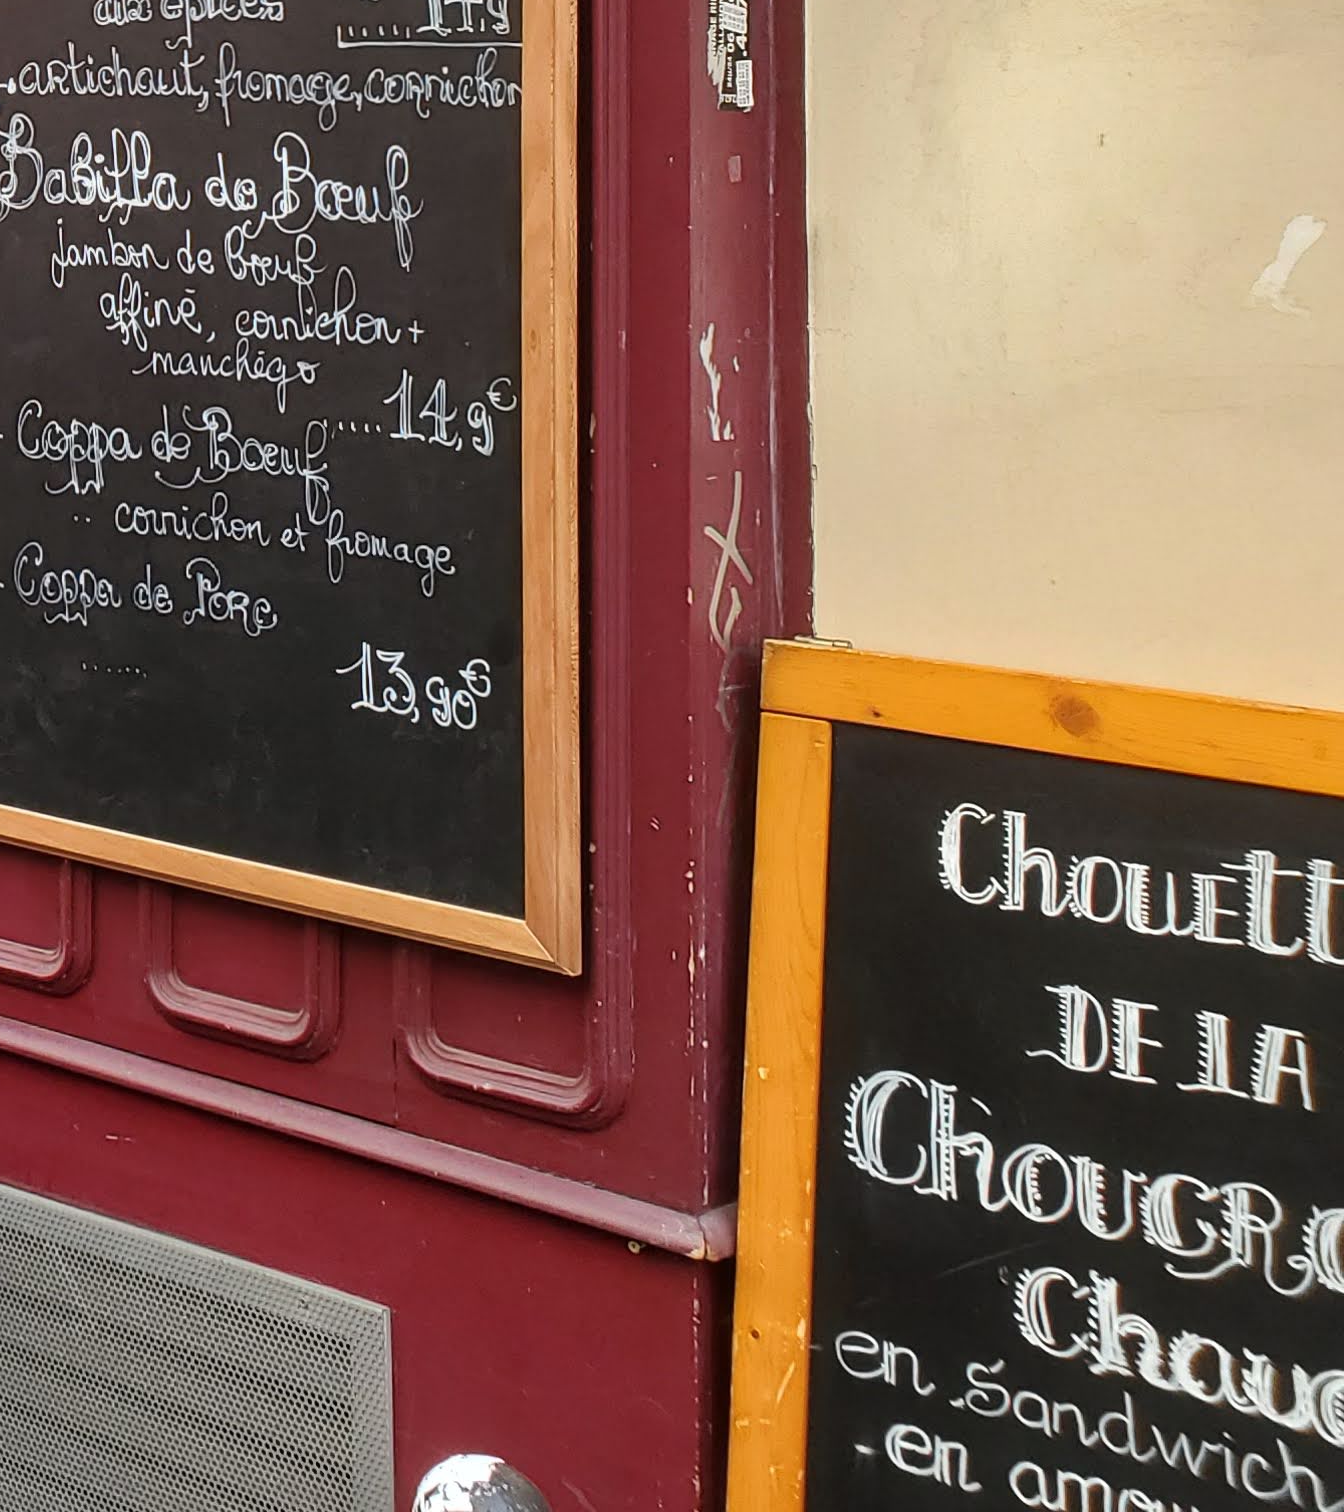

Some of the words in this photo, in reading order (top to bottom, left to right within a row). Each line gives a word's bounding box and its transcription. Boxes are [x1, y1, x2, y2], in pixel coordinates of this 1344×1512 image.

[205, 151, 258, 214] de
[50, 217, 171, 288] jambon
[175, 229, 214, 274] de
[15, 397, 143, 495] Coppa
[150, 404, 192, 464] de
[113, 491, 271, 549] cornichon
[279, 513, 308, 552] et
[324, 509, 457, 598] fromage
[12, 541, 123, 627] Coppa
[132, 563, 174, 615] de
[1026, 983, 1166, 1087] DE
[1178, 1009, 1316, 1115] LA
[834, 1330, 937, 1398] en
[884, 1423, 982, 1492] en
